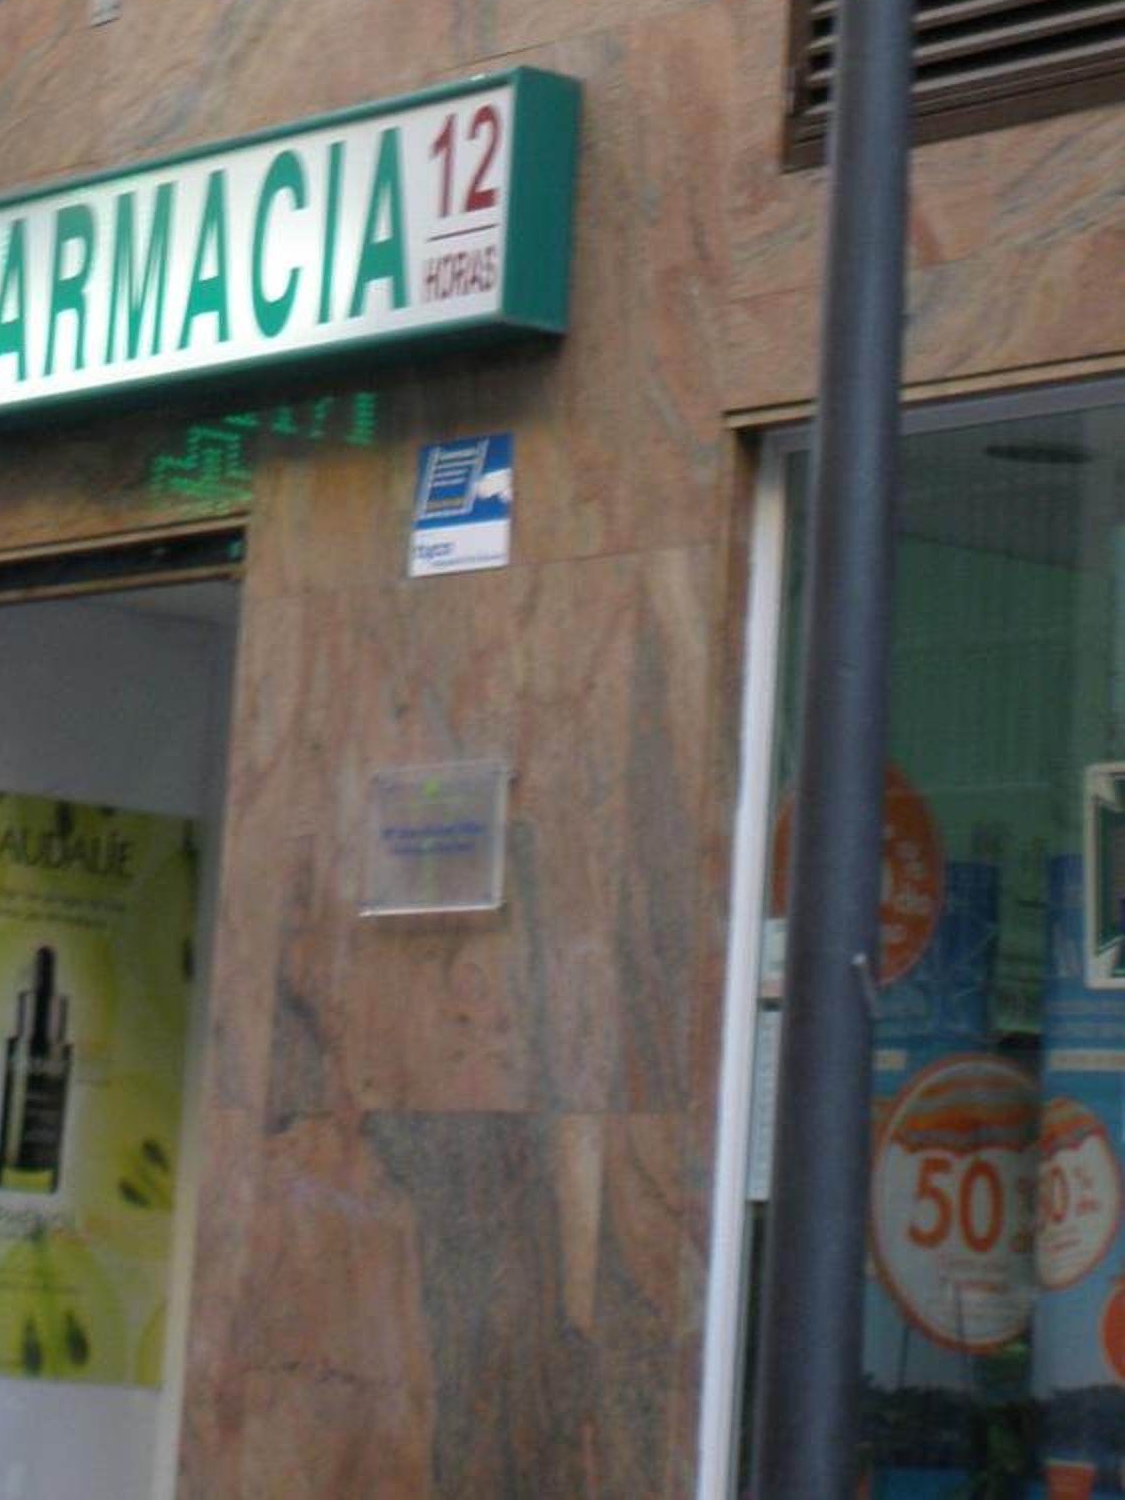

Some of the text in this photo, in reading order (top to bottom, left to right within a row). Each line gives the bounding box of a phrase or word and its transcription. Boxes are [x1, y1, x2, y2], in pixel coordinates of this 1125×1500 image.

[428, 103, 503, 219] 12
[421, 245, 497, 305] HORAS
[907, 1156, 1005, 1253] 50
